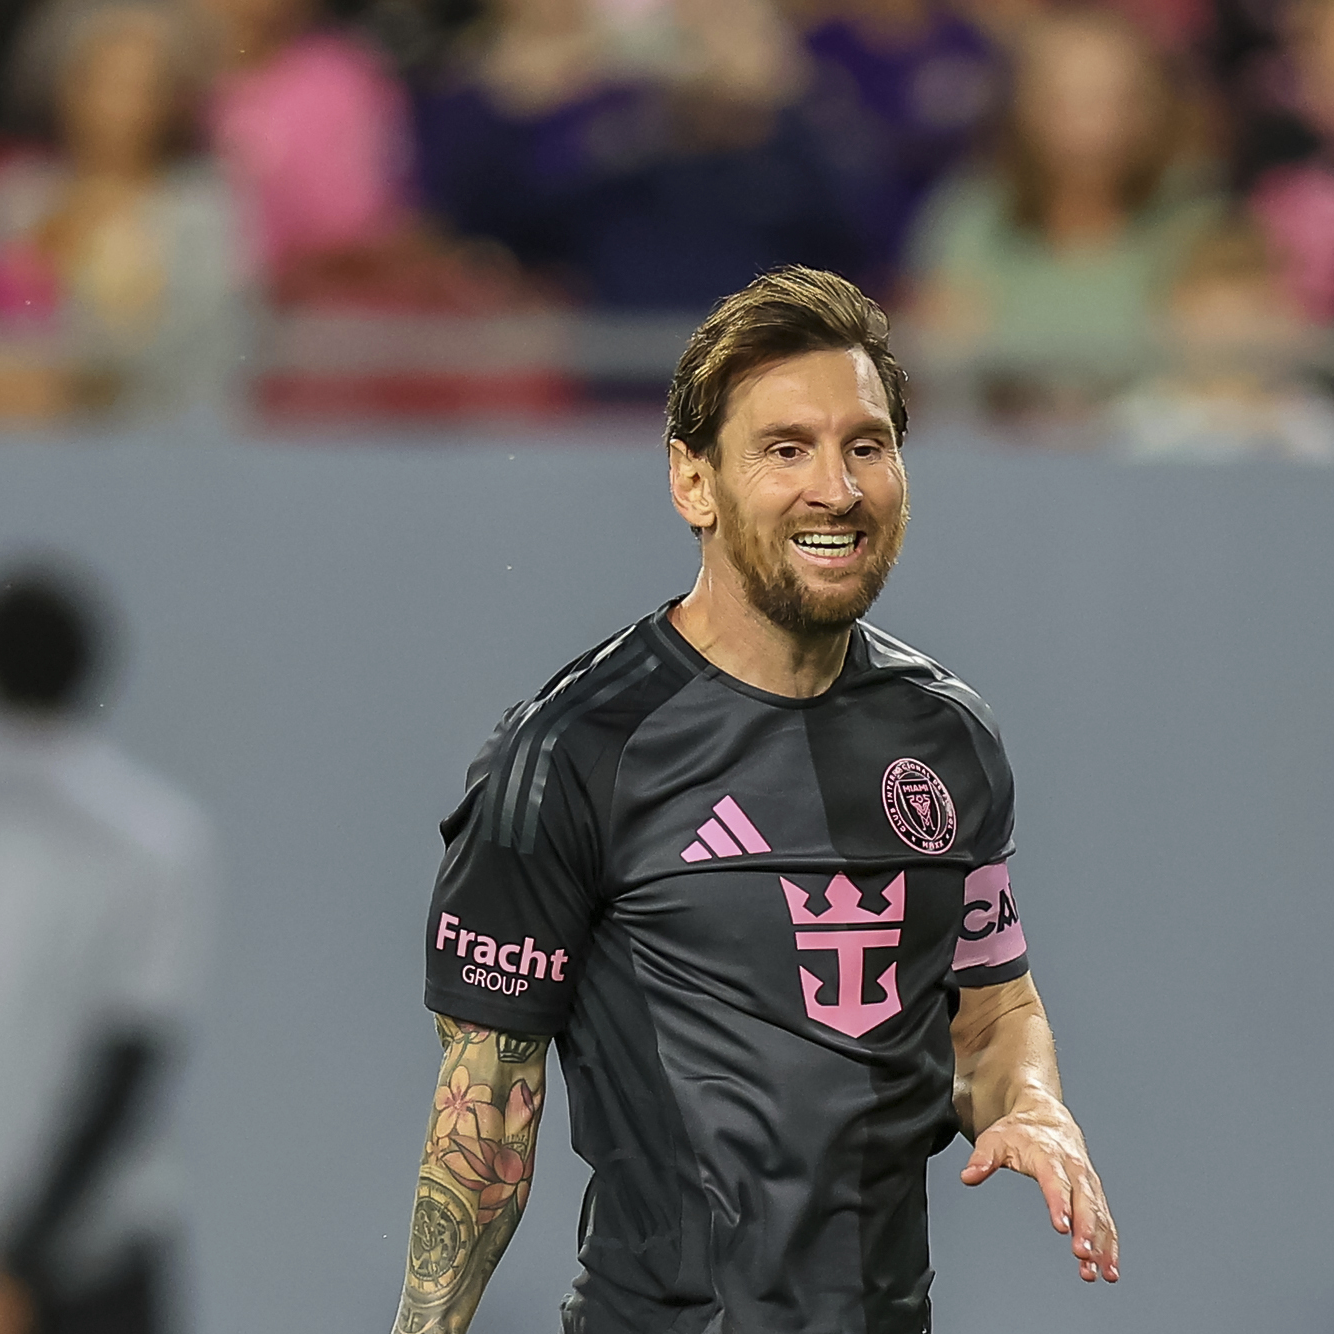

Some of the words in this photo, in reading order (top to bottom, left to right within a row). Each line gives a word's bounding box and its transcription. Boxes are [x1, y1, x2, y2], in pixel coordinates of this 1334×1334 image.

[902, 784, 929, 793] MIAMI
[958, 883, 1019, 941] CA
[435, 911, 569, 982] Fracht
[462, 964, 529, 997] GROUP
